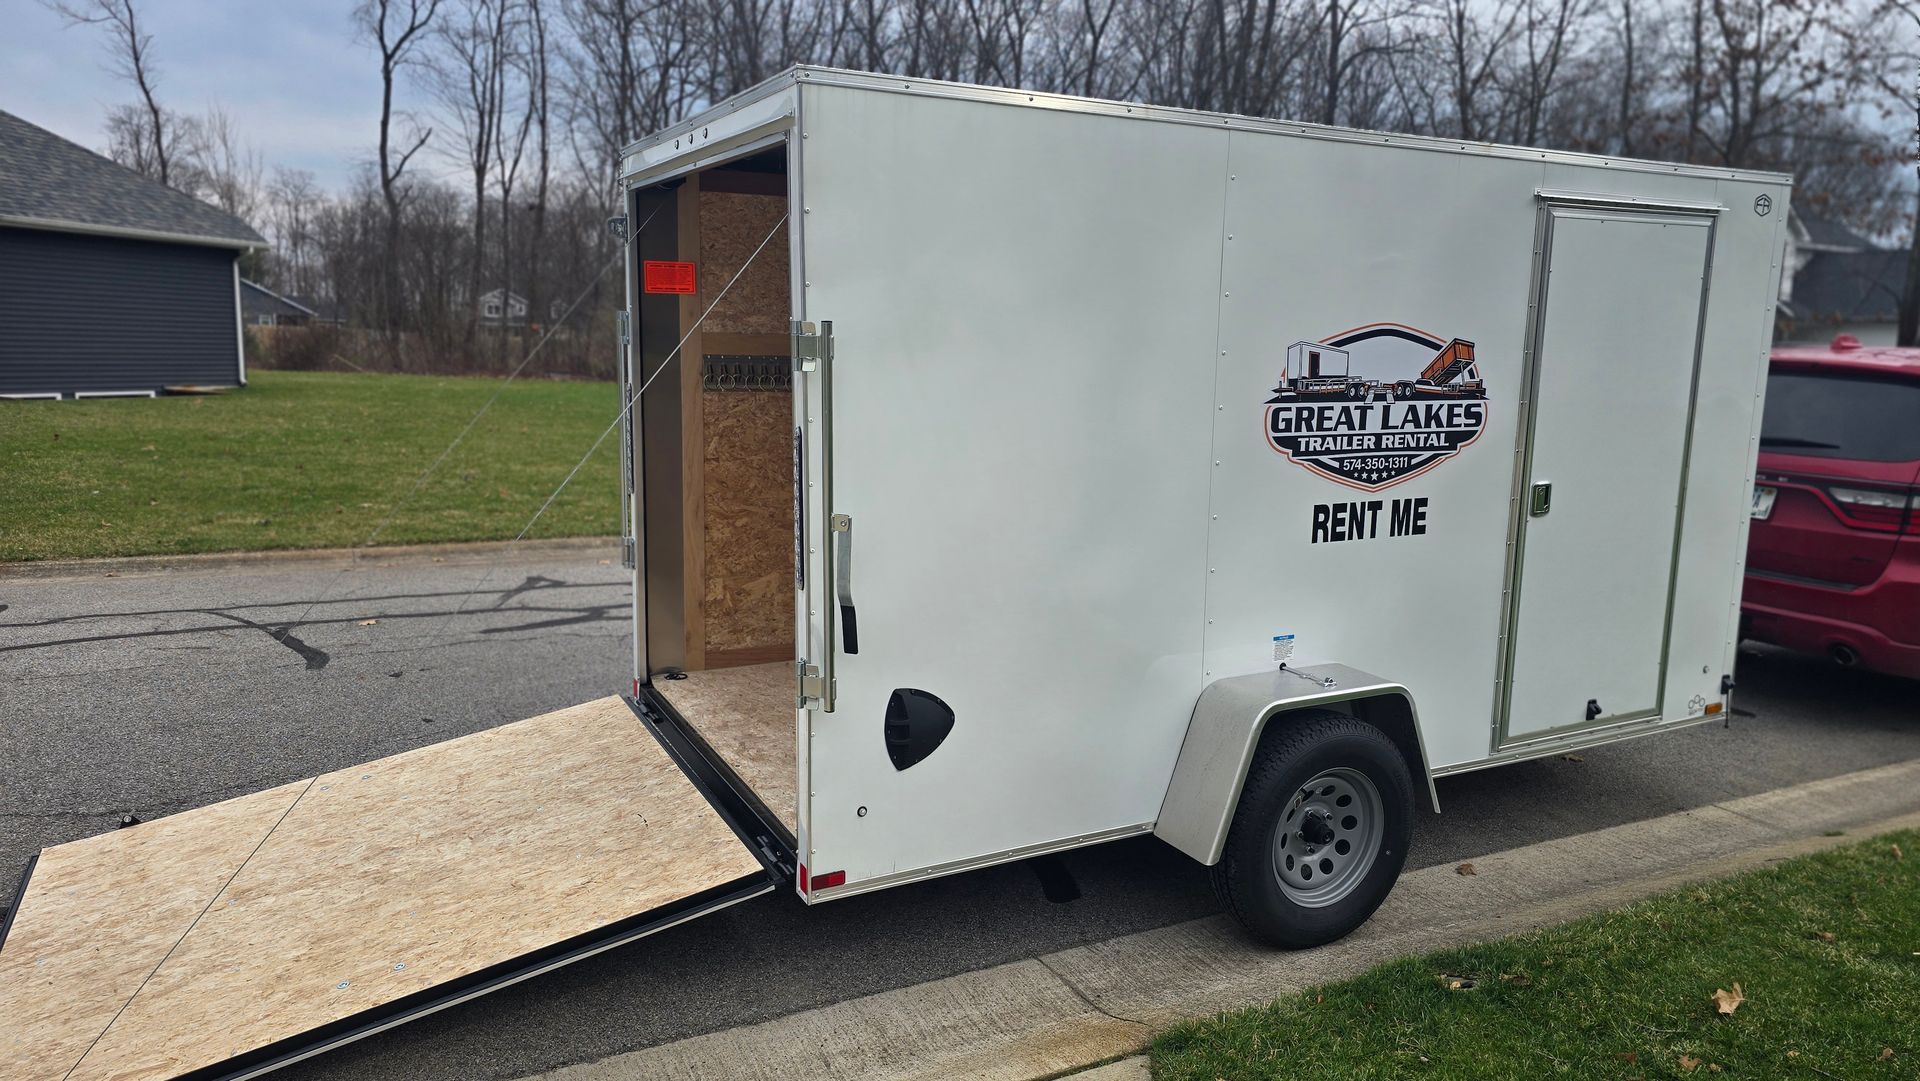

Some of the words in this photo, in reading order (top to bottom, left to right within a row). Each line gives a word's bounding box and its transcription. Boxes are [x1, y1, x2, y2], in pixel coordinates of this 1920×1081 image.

[1271, 405, 1374, 433] GREAT
[1381, 402, 1483, 430] LAKES
[1298, 435, 1376, 452] TRAILER
[1382, 433, 1450, 449] RENTAL
[1343, 457, 1408, 471] 574-350-1311
[1311, 500, 1383, 544] RENT
[1389, 497, 1429, 537] ME
